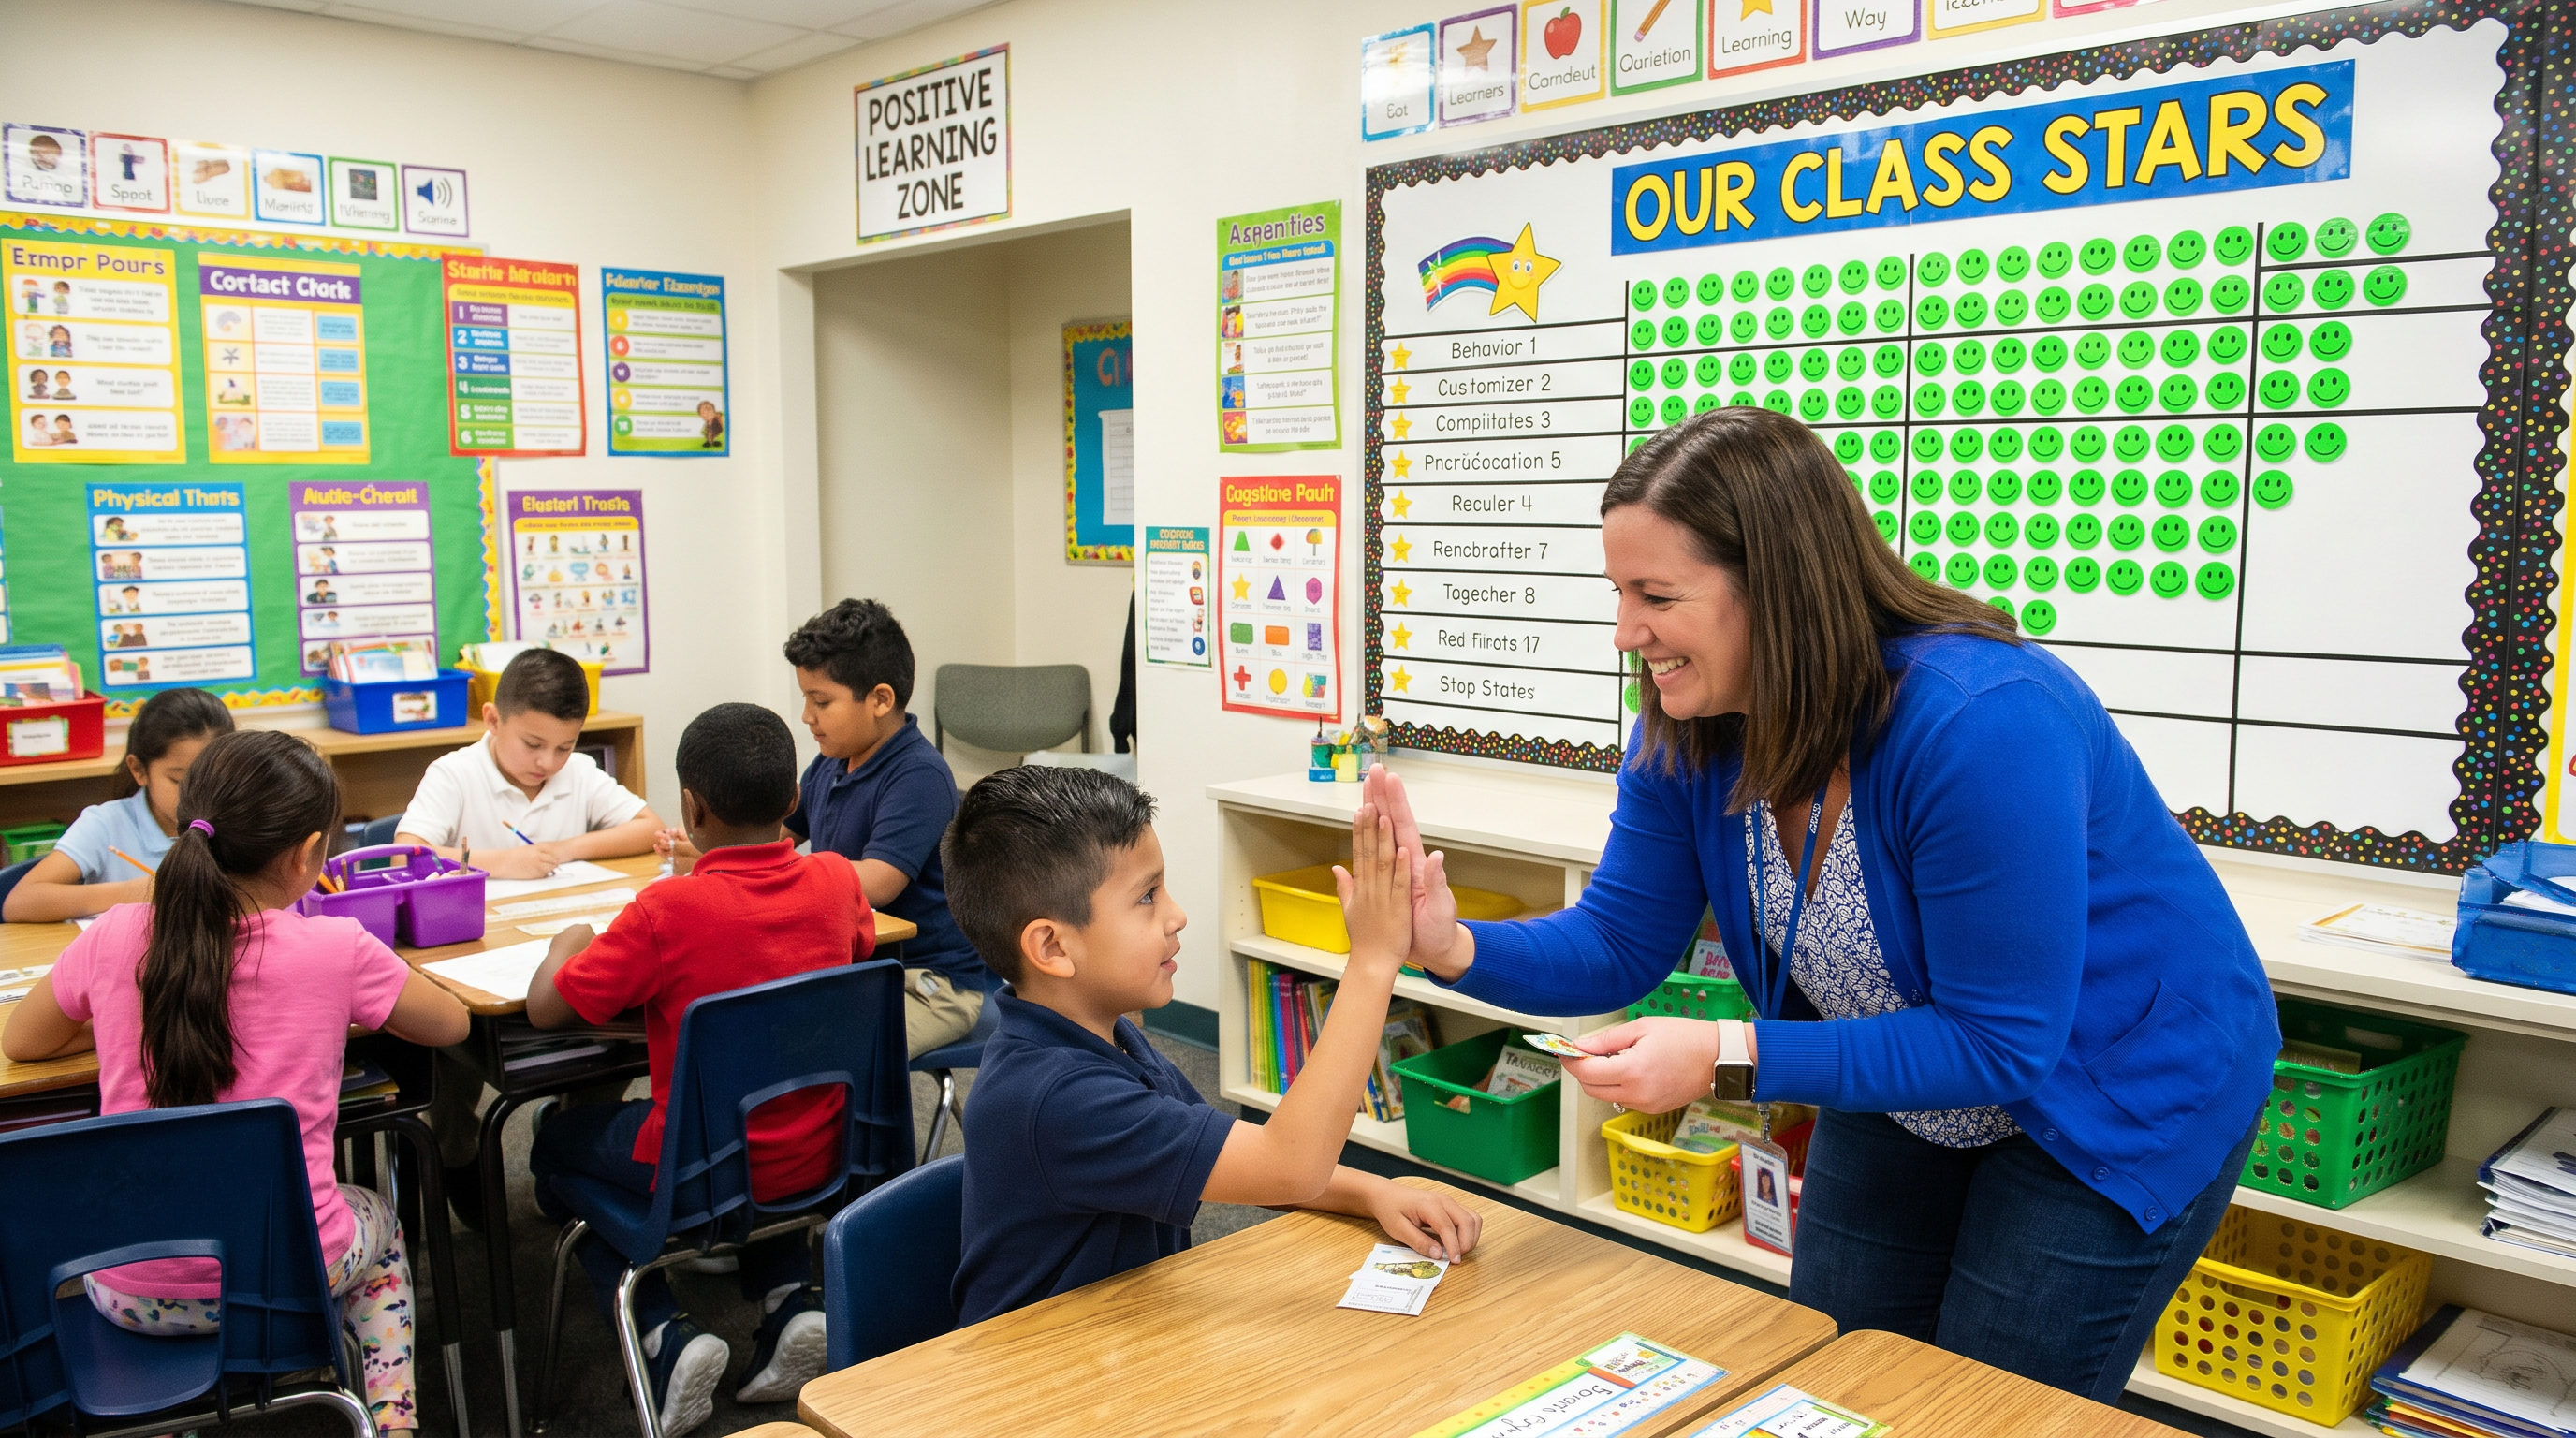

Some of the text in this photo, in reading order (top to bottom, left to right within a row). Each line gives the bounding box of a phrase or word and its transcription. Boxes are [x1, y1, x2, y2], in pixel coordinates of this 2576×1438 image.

[1845, 7, 1886, 31] Way
[1722, 28, 1792, 54] Learning
[869, 67, 992, 136] POSITIVE
[1449, 85, 1504, 106] Learners
[866, 116, 997, 181] LEARNING
[1623, 81, 2329, 242] OUR CLASS STARS
[897, 171, 964, 220] ZONE
[96, 253, 165, 275] Pours
[457, 330, 467, 345] 2
[1452, 336, 1537, 360] Behavior 1
[458, 356, 468, 370] 3
[1438, 374, 1551, 397] Customizer 2
[1541, 410, 1551, 429] 3
[461, 430, 472, 444] 6
[1551, 450, 1561, 469] 5
[93, 489, 181, 511] Physical
[1452, 494, 1532, 512] Reculer 4
[1433, 540, 1548, 560] Rencbrafter 7
[1442, 583, 1535, 606] Togecher 8
[1439, 629, 1465, 648] Red
[1521, 635, 1540, 653] 17
[1440, 675, 1536, 699] Stop States
